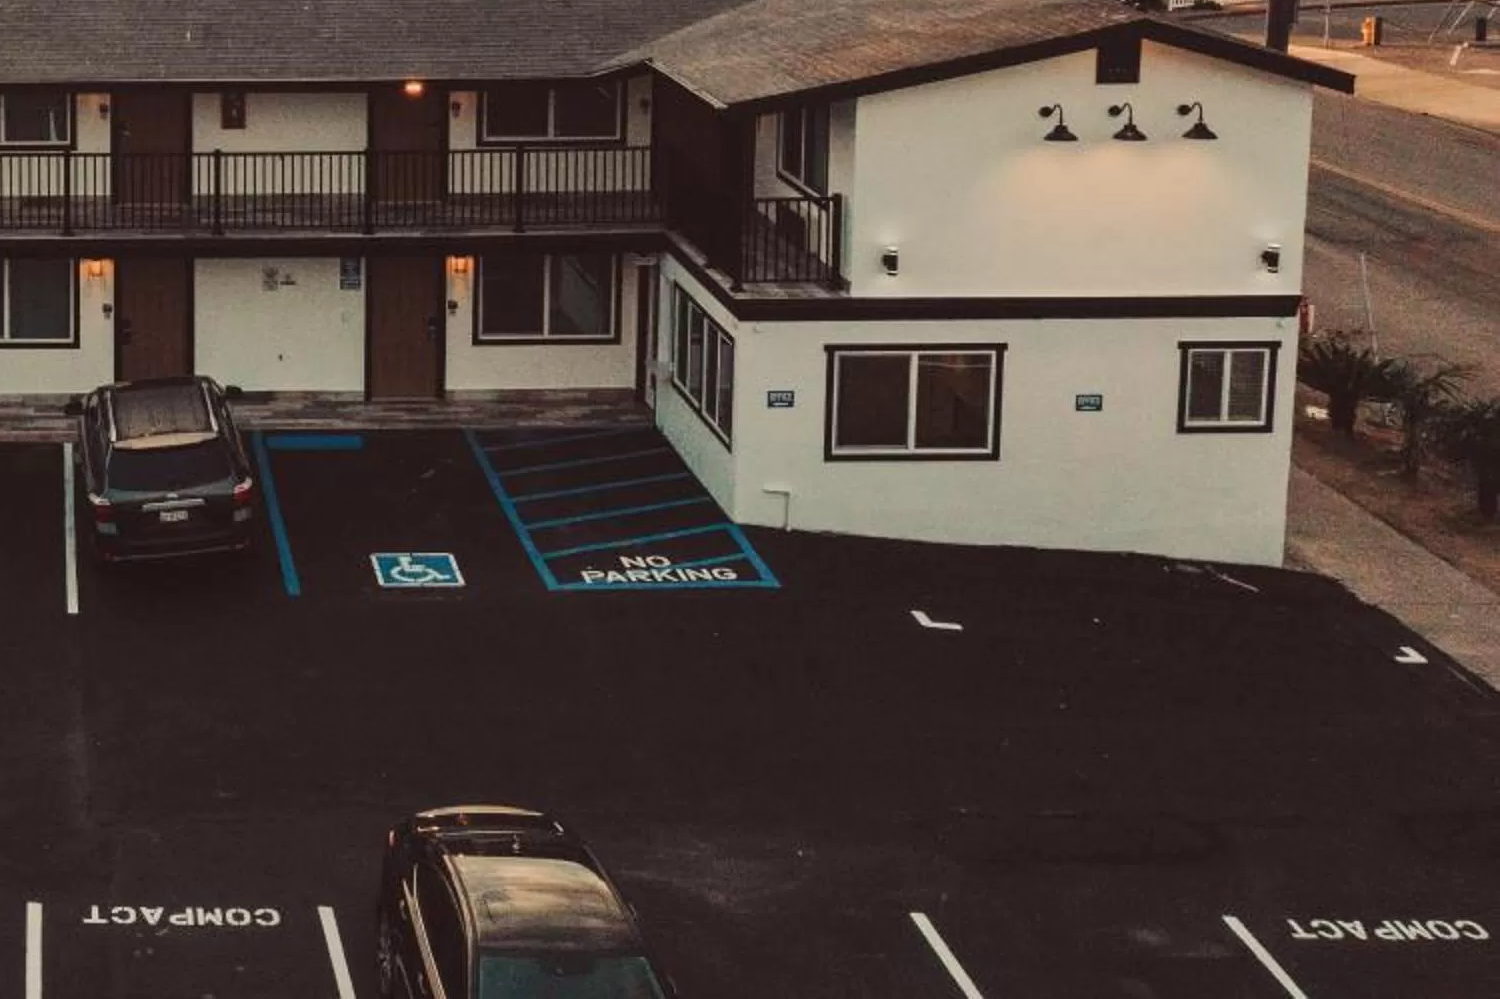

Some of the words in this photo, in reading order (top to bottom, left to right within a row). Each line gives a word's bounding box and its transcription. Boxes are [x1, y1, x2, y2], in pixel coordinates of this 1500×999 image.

[619, 555, 671, 568] NO
[580, 568, 738, 584] PARKING
[82, 905, 282, 926] COMPACT
[1286, 918, 1490, 940] COMPACT
